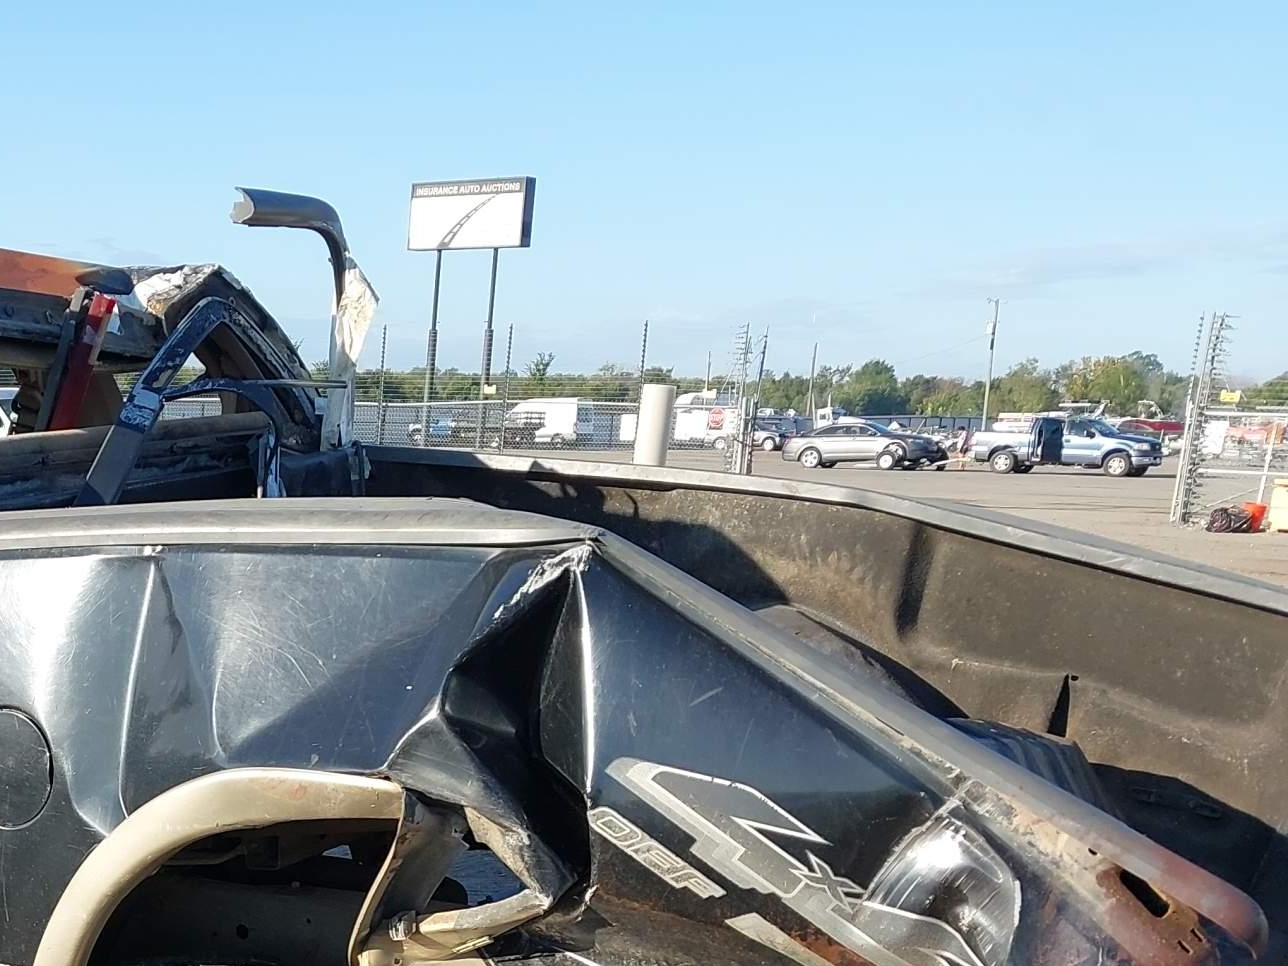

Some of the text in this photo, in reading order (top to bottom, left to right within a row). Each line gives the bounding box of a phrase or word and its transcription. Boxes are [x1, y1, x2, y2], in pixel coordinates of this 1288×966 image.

[416, 182, 521, 196] INSURANCE AUTO AUCTIONS
